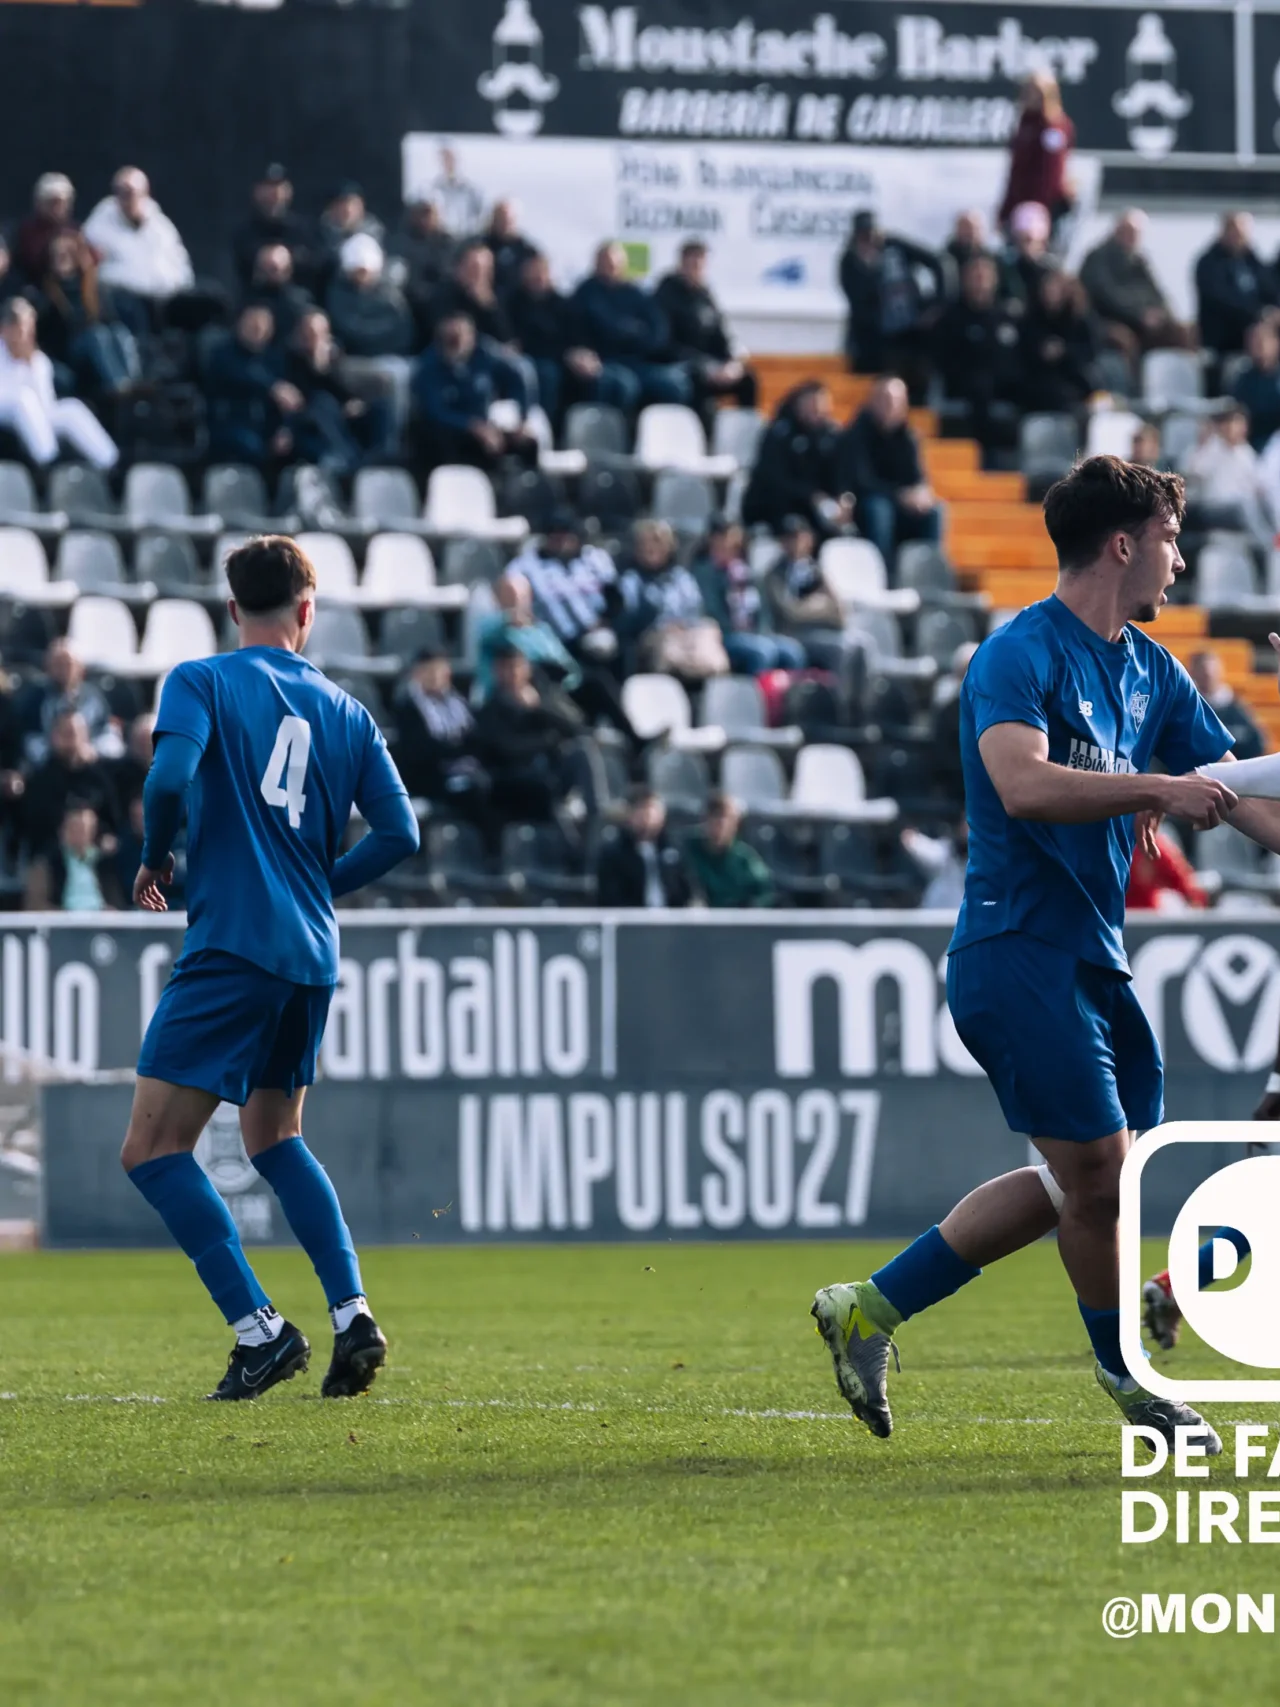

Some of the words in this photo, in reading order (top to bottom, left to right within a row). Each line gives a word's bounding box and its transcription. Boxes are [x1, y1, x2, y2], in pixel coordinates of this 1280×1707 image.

[578, 4, 886, 76] Moustache
[897, 13, 1097, 83] Barber
[796, 93, 841, 140] DE
[846, 94, 1018, 143] CABALLER
[260, 714, 311, 829] 4
[318, 928, 589, 1080] arballo
[459, 1089, 881, 1233] IMPULSO27
